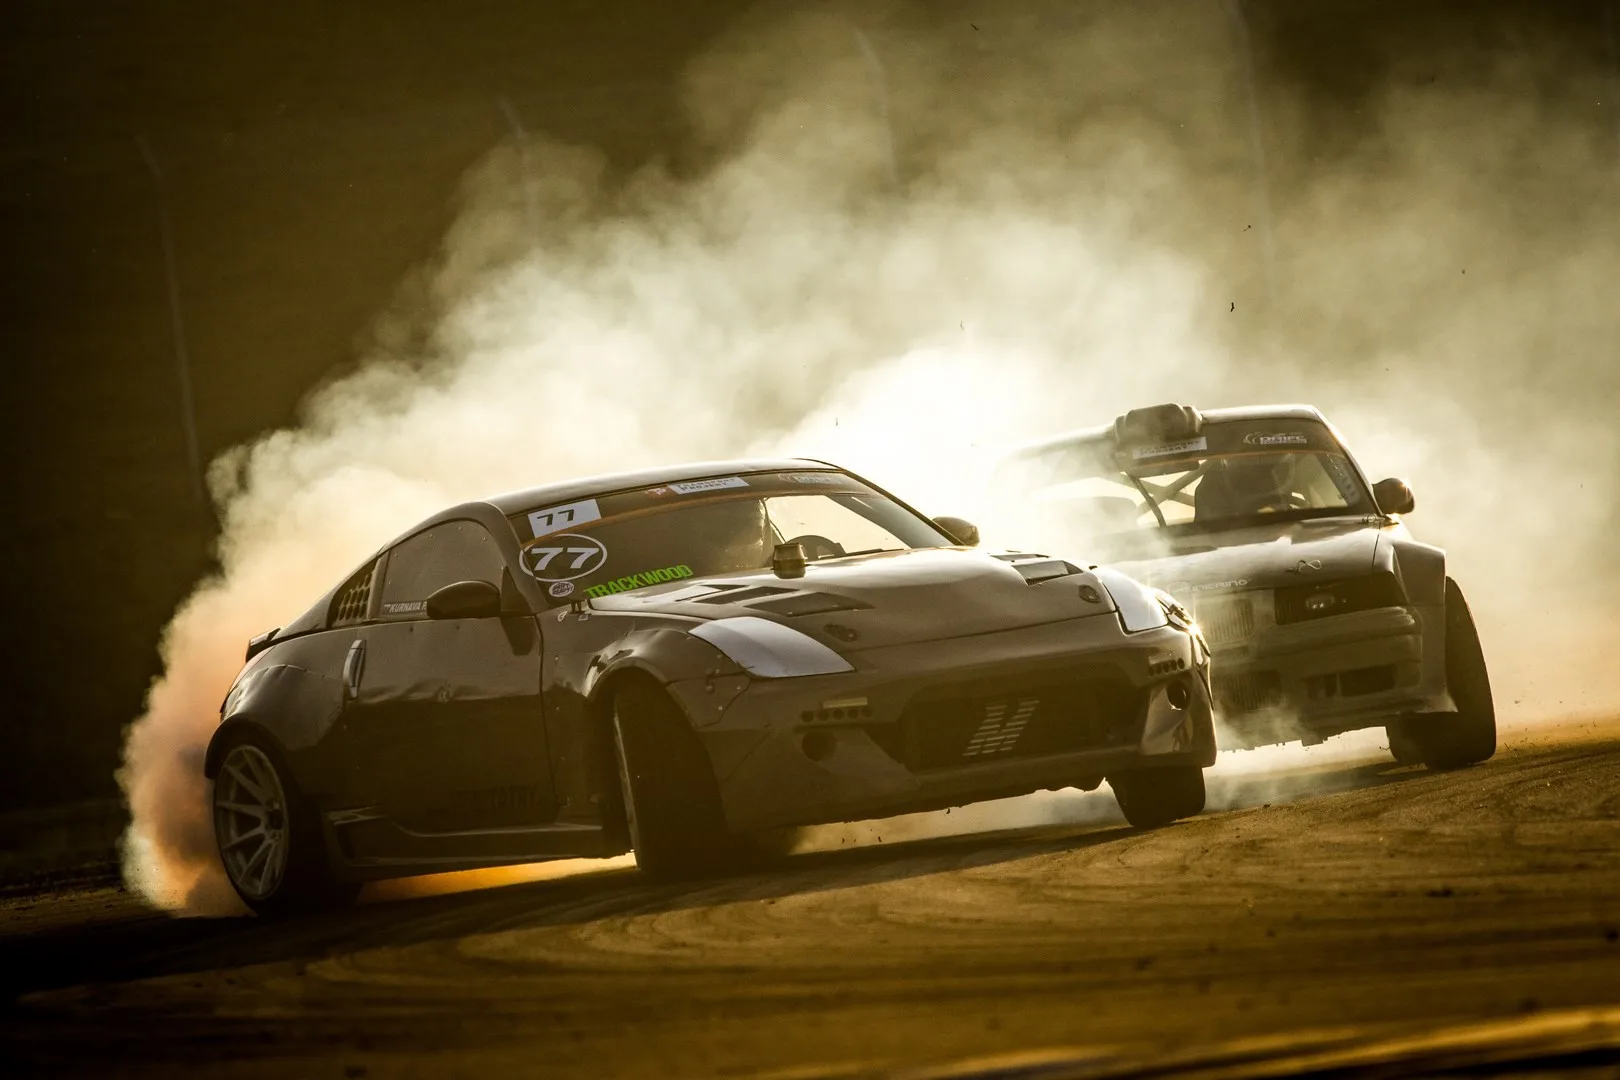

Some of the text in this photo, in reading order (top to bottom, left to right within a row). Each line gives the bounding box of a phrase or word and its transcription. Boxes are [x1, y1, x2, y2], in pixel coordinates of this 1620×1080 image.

[537, 509, 576, 526] 77
[531, 547, 600, 571] 77
[584, 564, 694, 599] TRACKWOOD
[388, 601, 421, 614] KURNAVA
